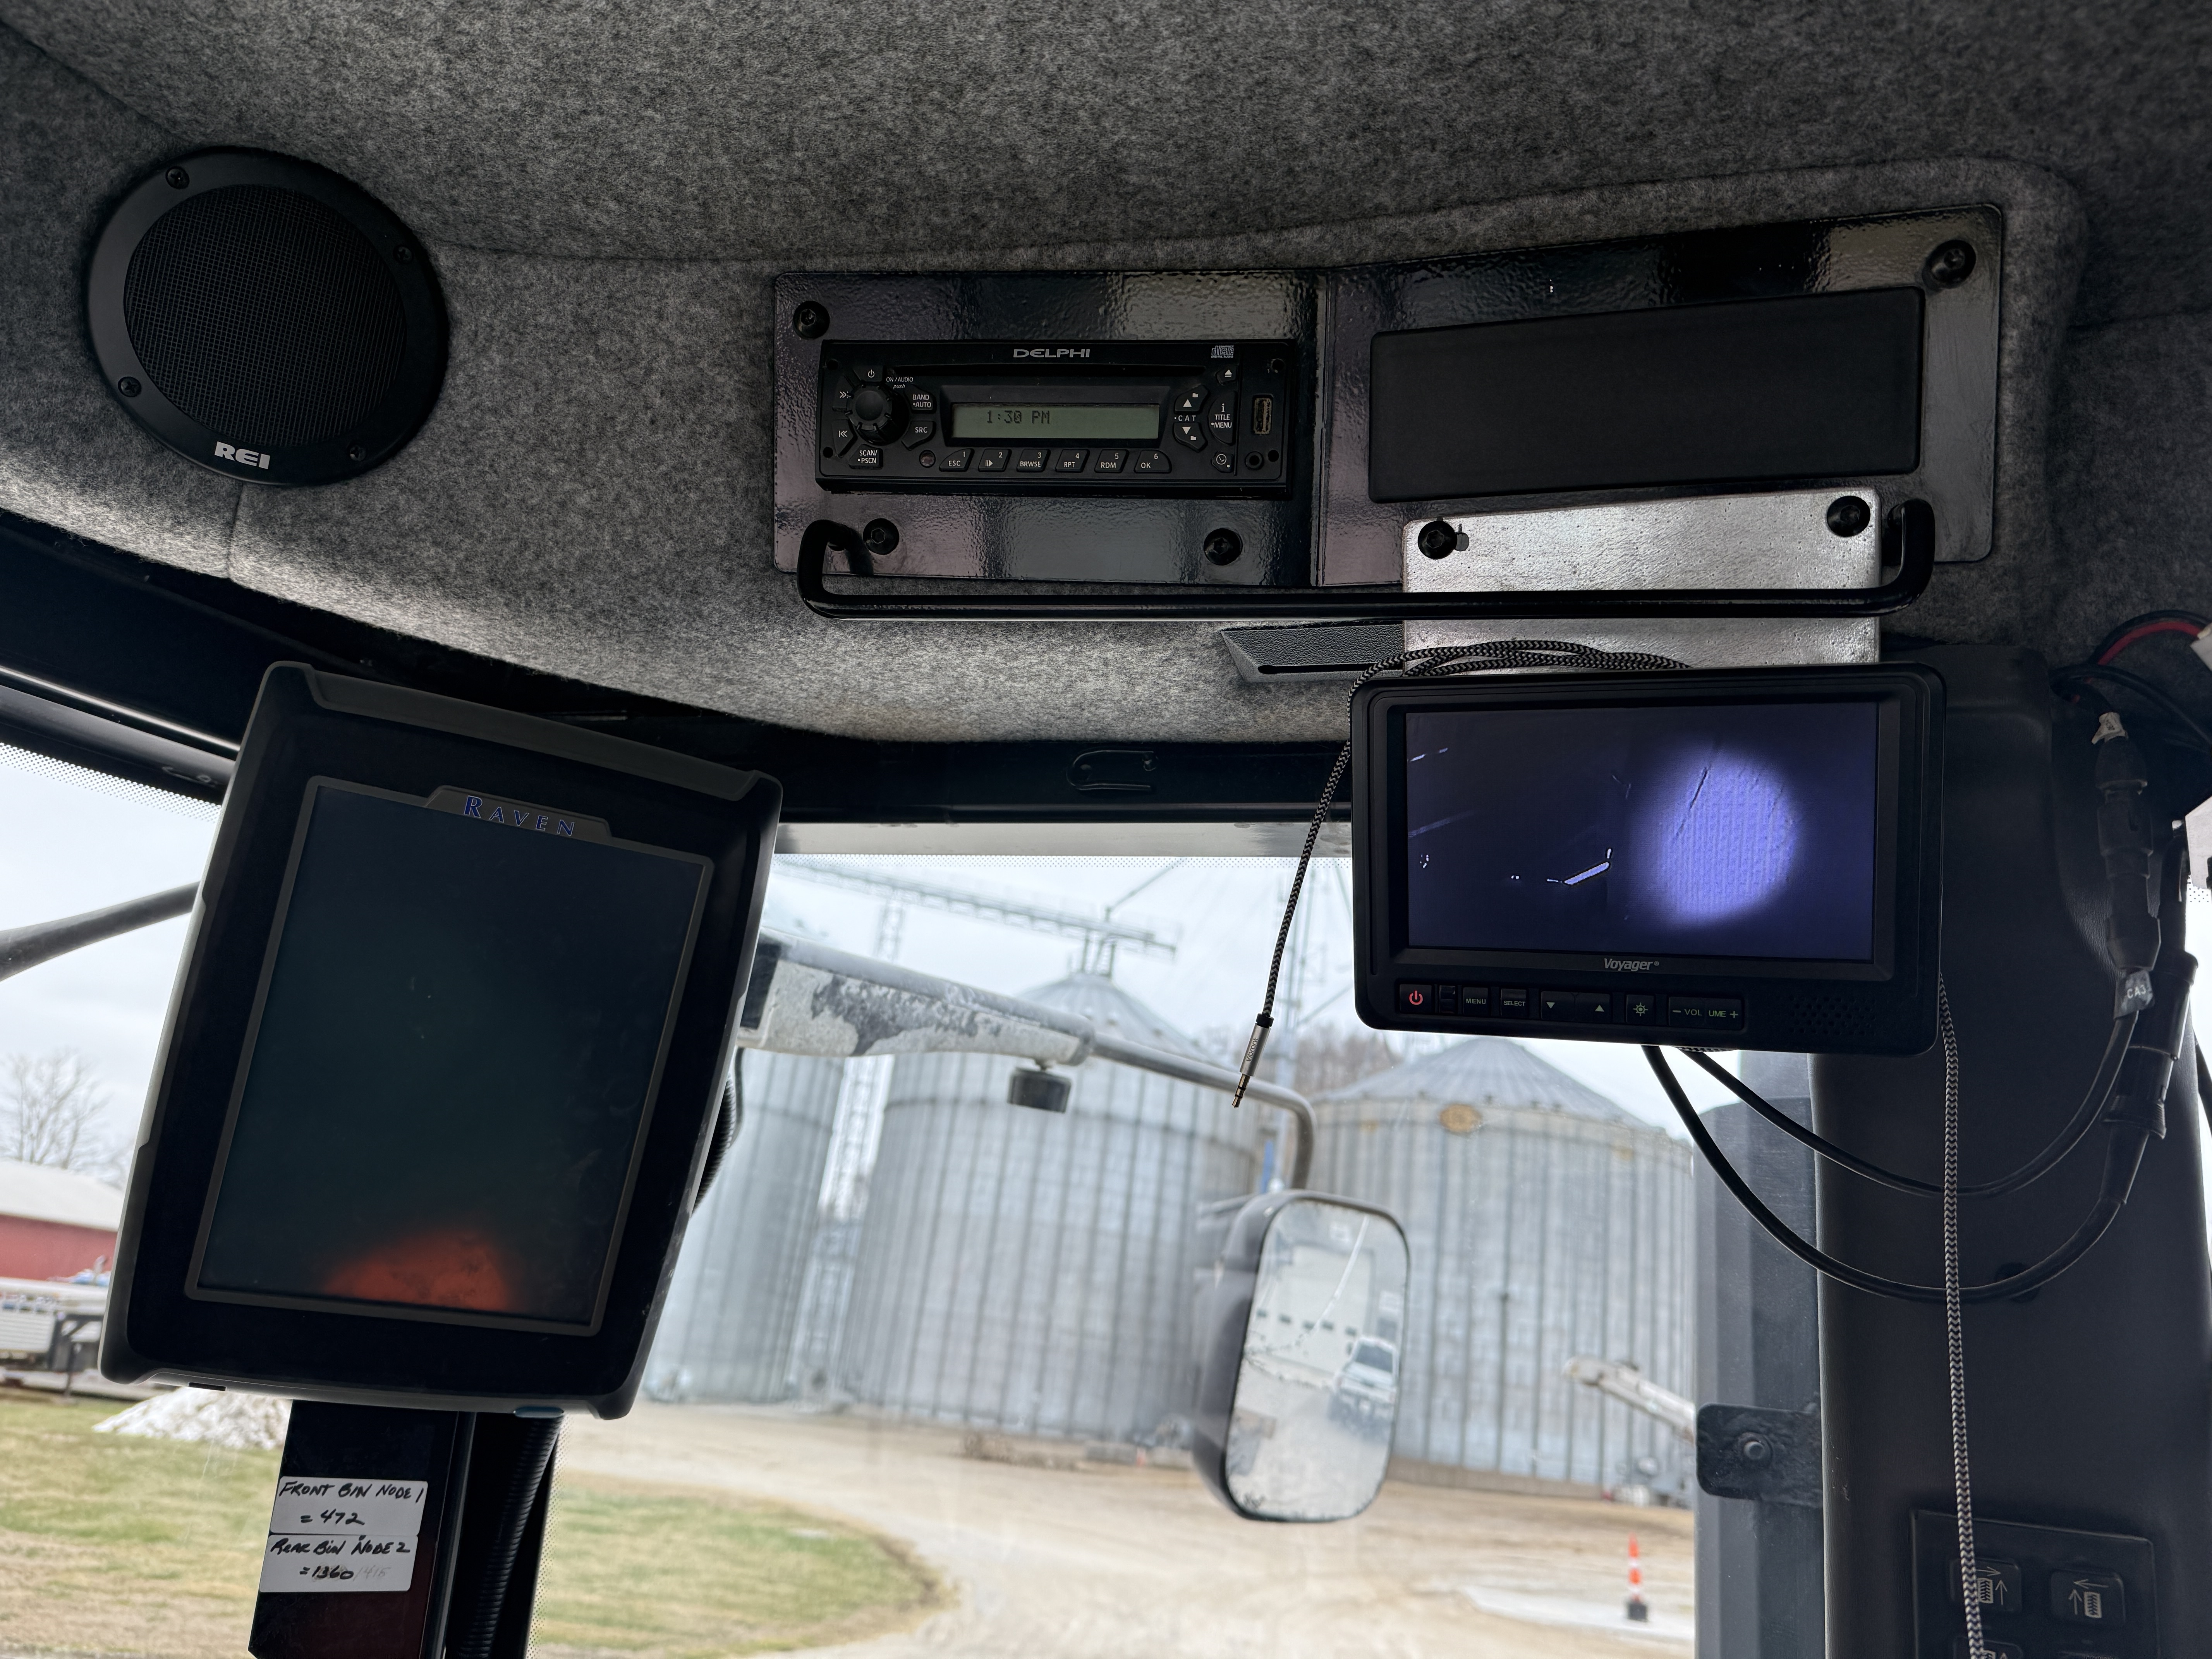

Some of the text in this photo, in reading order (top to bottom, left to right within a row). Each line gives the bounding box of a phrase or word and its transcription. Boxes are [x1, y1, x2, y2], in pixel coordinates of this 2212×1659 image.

[1013, 349, 1090, 358] DELPHI
[987, 410, 1050, 424] 1:30 PM
[214, 441, 271, 470] REI
[464, 795, 575, 837] RAVEN
[279, 1481, 335, 1497] FRONT
[338, 1483, 372, 1498] BIN
[376, 1484, 412, 1499] NODE
[320, 1508, 365, 1525] 472
[396, 1542, 410, 1553] 2
